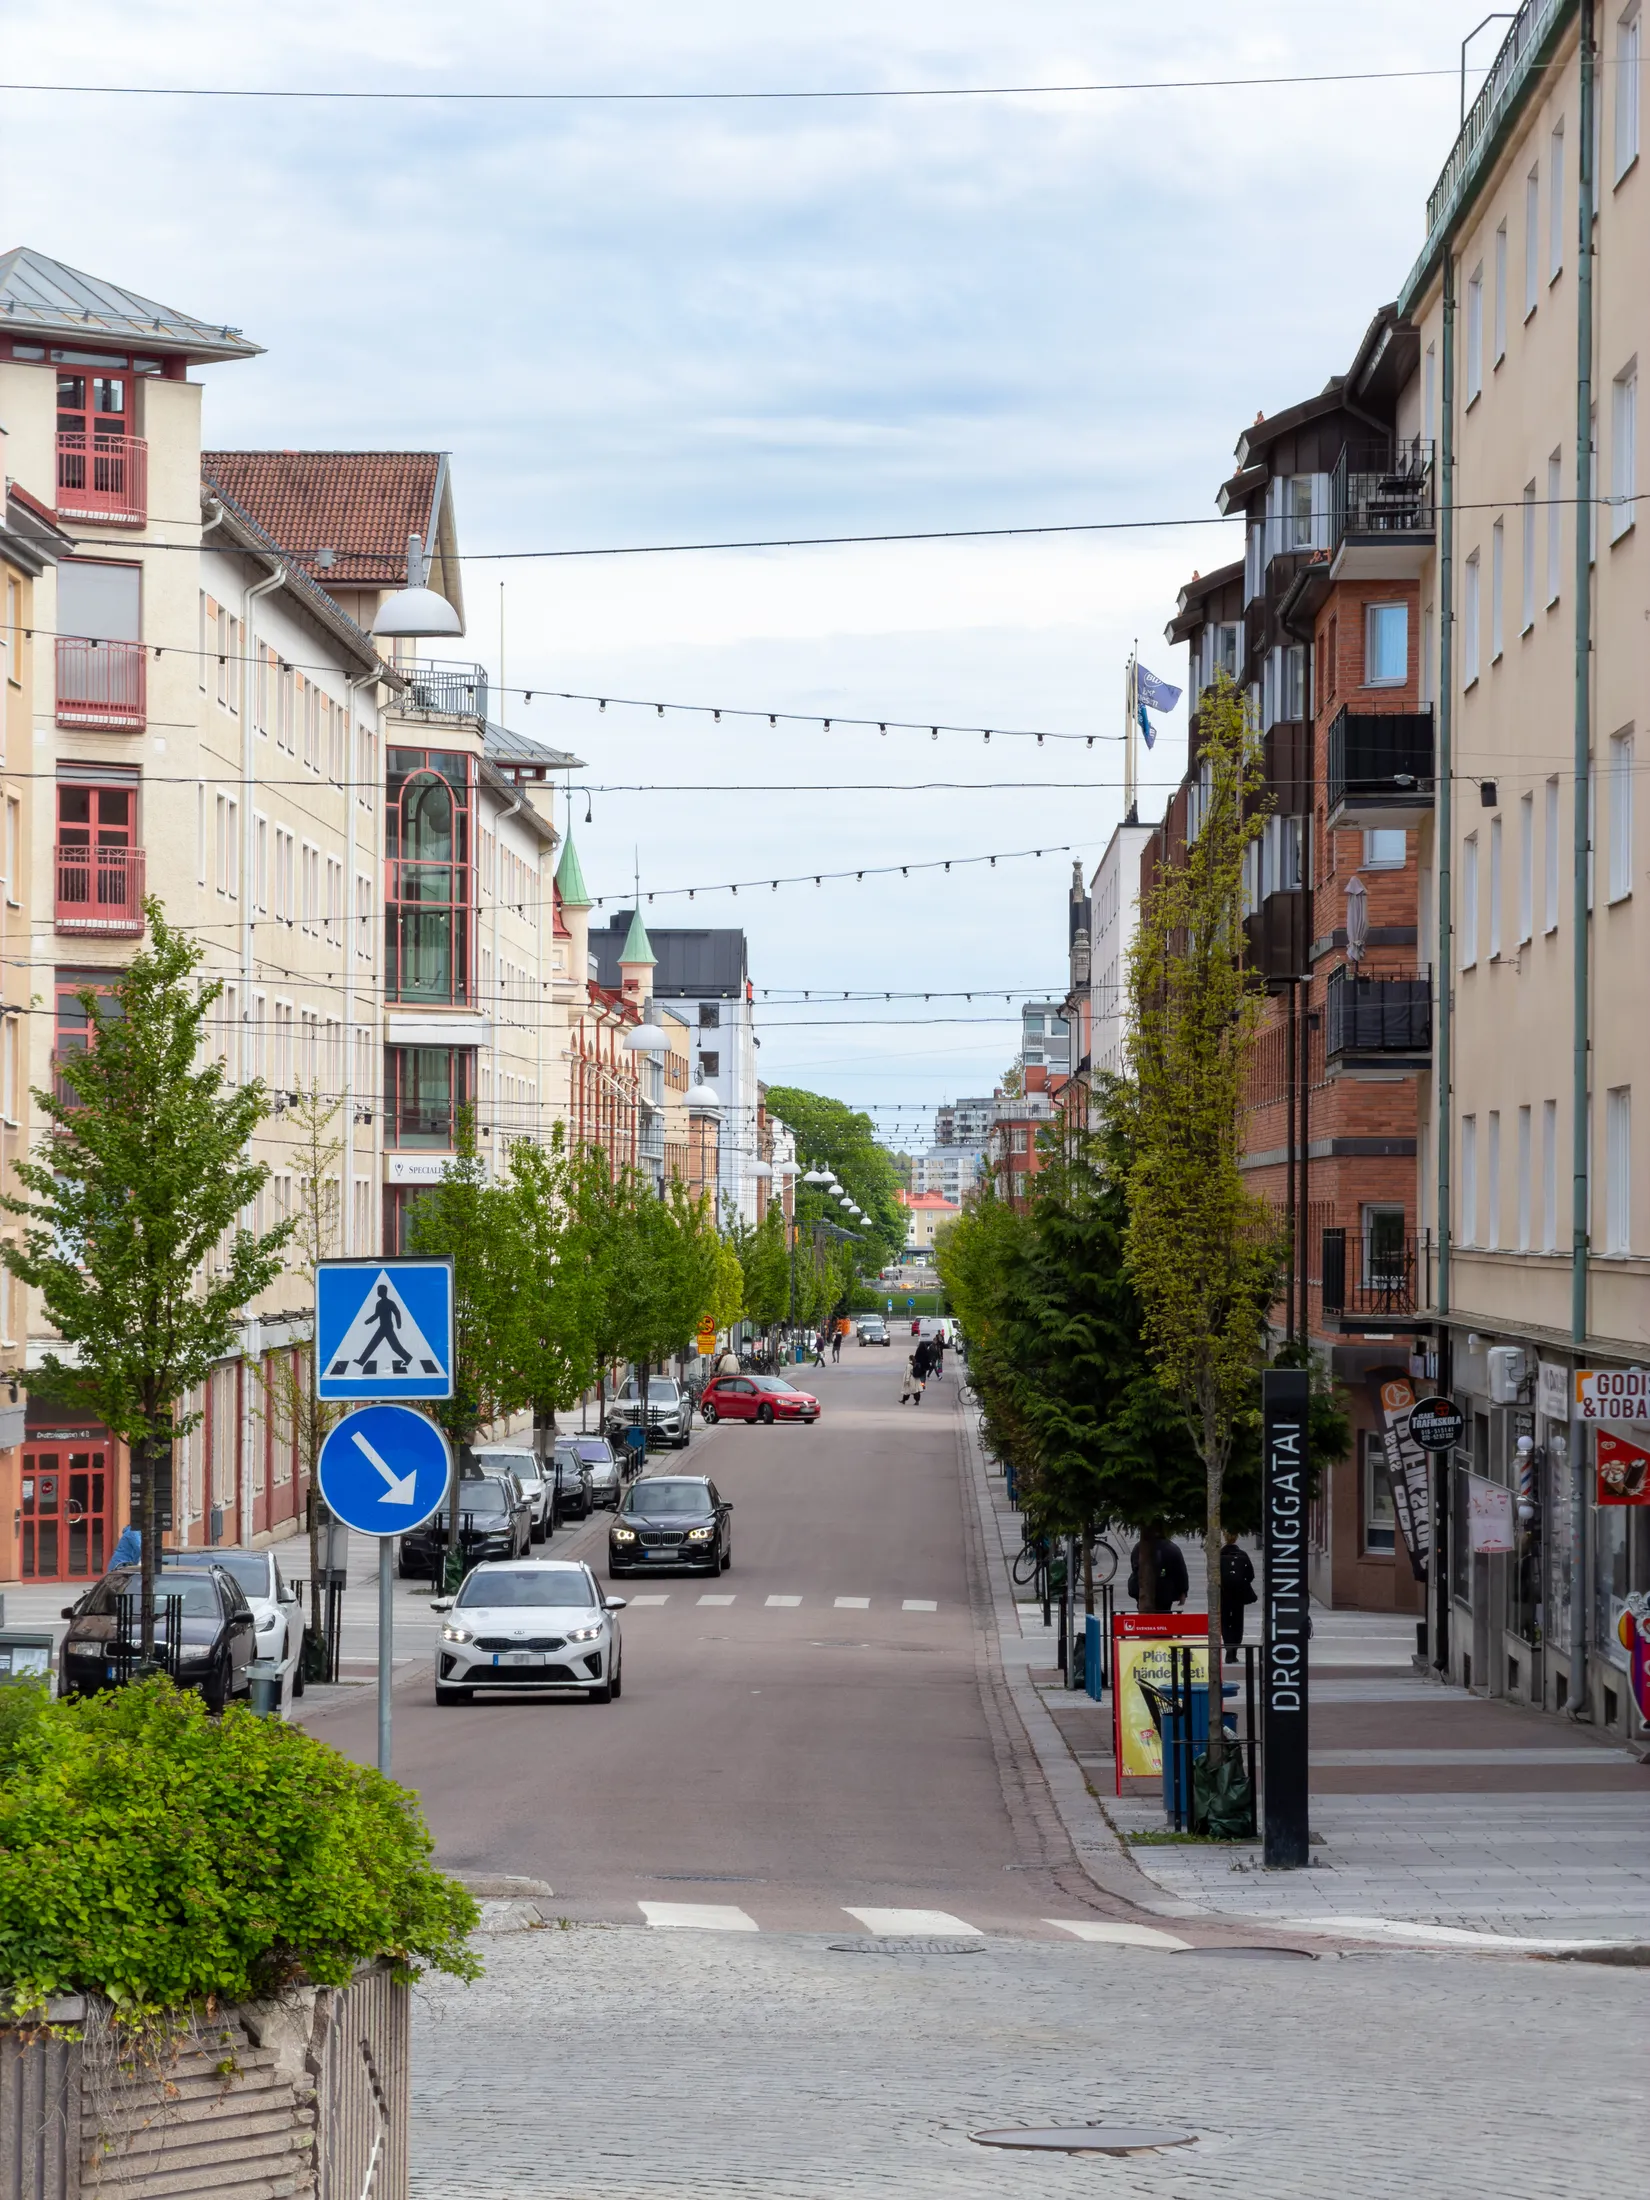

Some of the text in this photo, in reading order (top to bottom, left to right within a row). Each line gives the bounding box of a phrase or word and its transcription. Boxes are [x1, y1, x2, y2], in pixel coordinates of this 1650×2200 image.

[409, 1166, 445, 1174] SPECIALIS
[1597, 1373, 1650, 1396] GODI
[1583, 1397, 1650, 1418] &TOBA
[1412, 1415, 1461, 1429] TRAFIKSKOLA
[1418, 1412, 1435, 1420] ISAKS
[1143, 1650, 1194, 1666] Plötsit
[1133, 1667, 1173, 1679] hände
